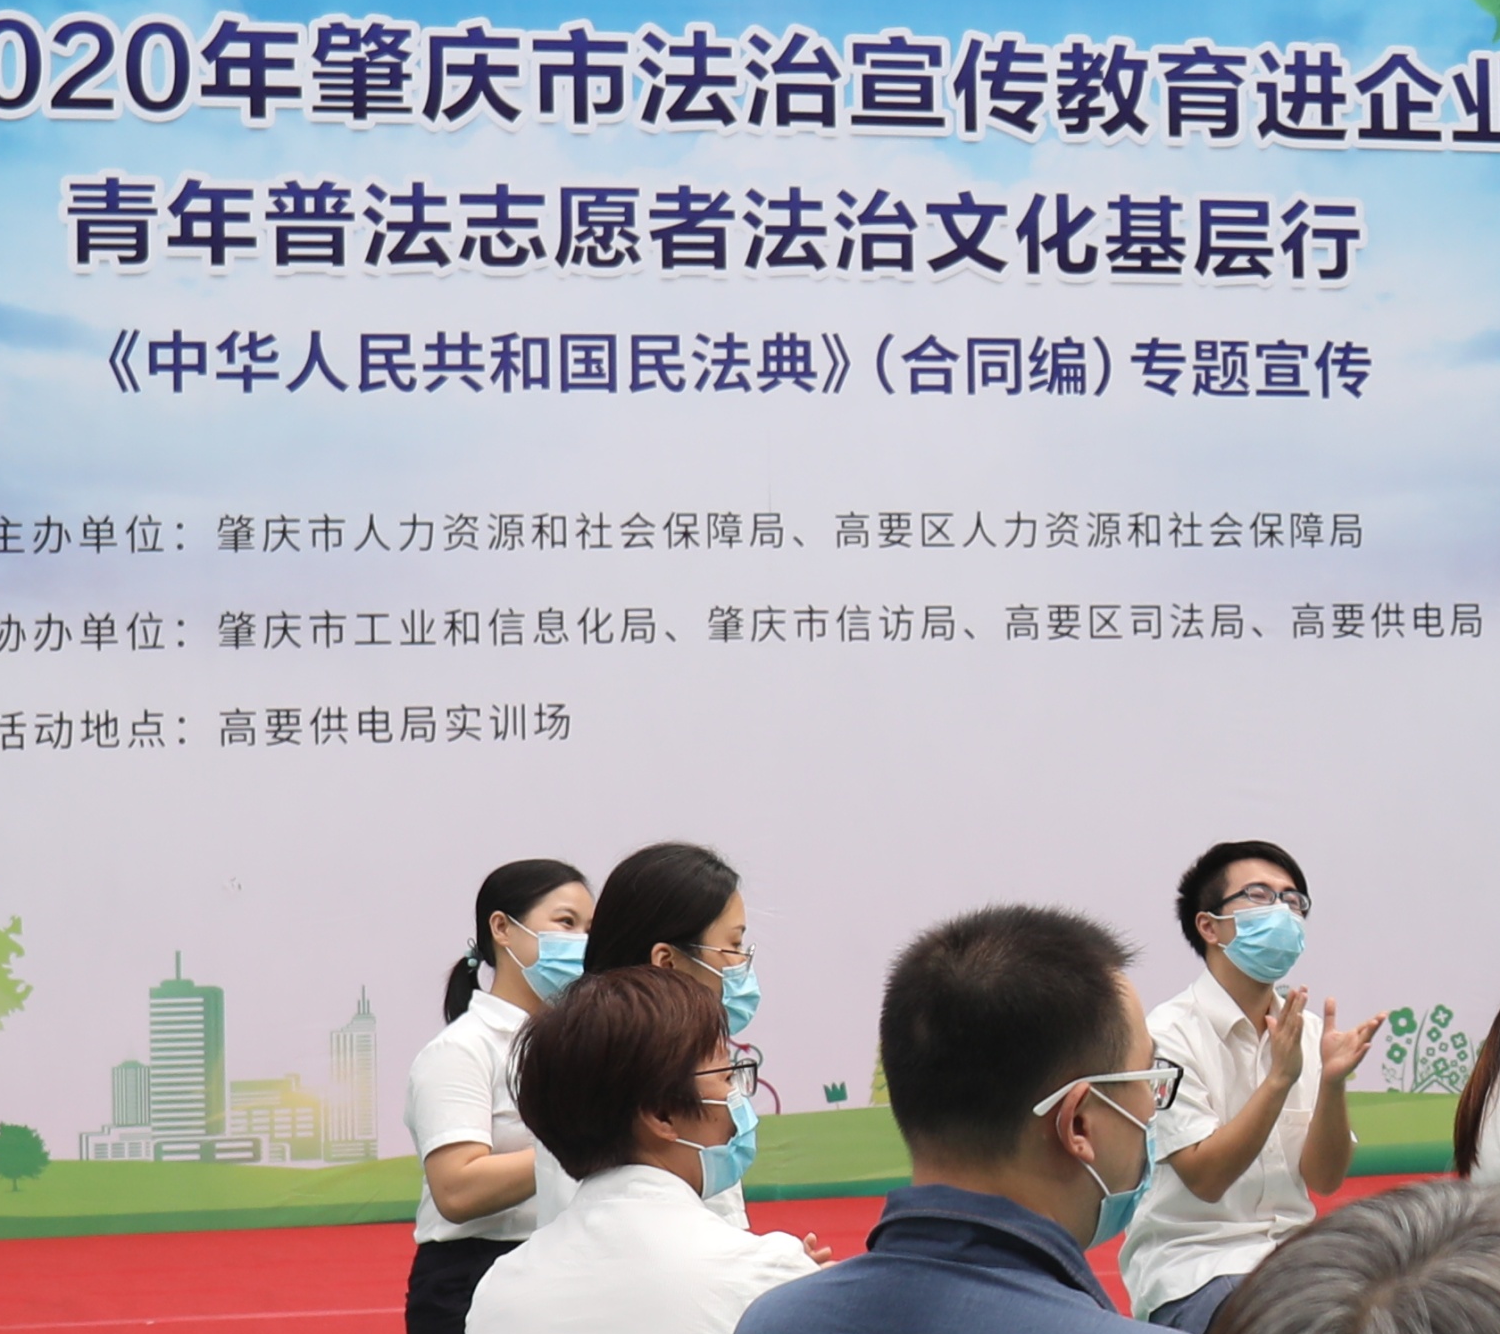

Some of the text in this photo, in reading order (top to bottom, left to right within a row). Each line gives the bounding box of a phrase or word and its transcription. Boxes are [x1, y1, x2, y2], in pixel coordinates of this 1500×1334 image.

[66, 175, 1362, 281] 青年普法志愿者法治文化基层行
